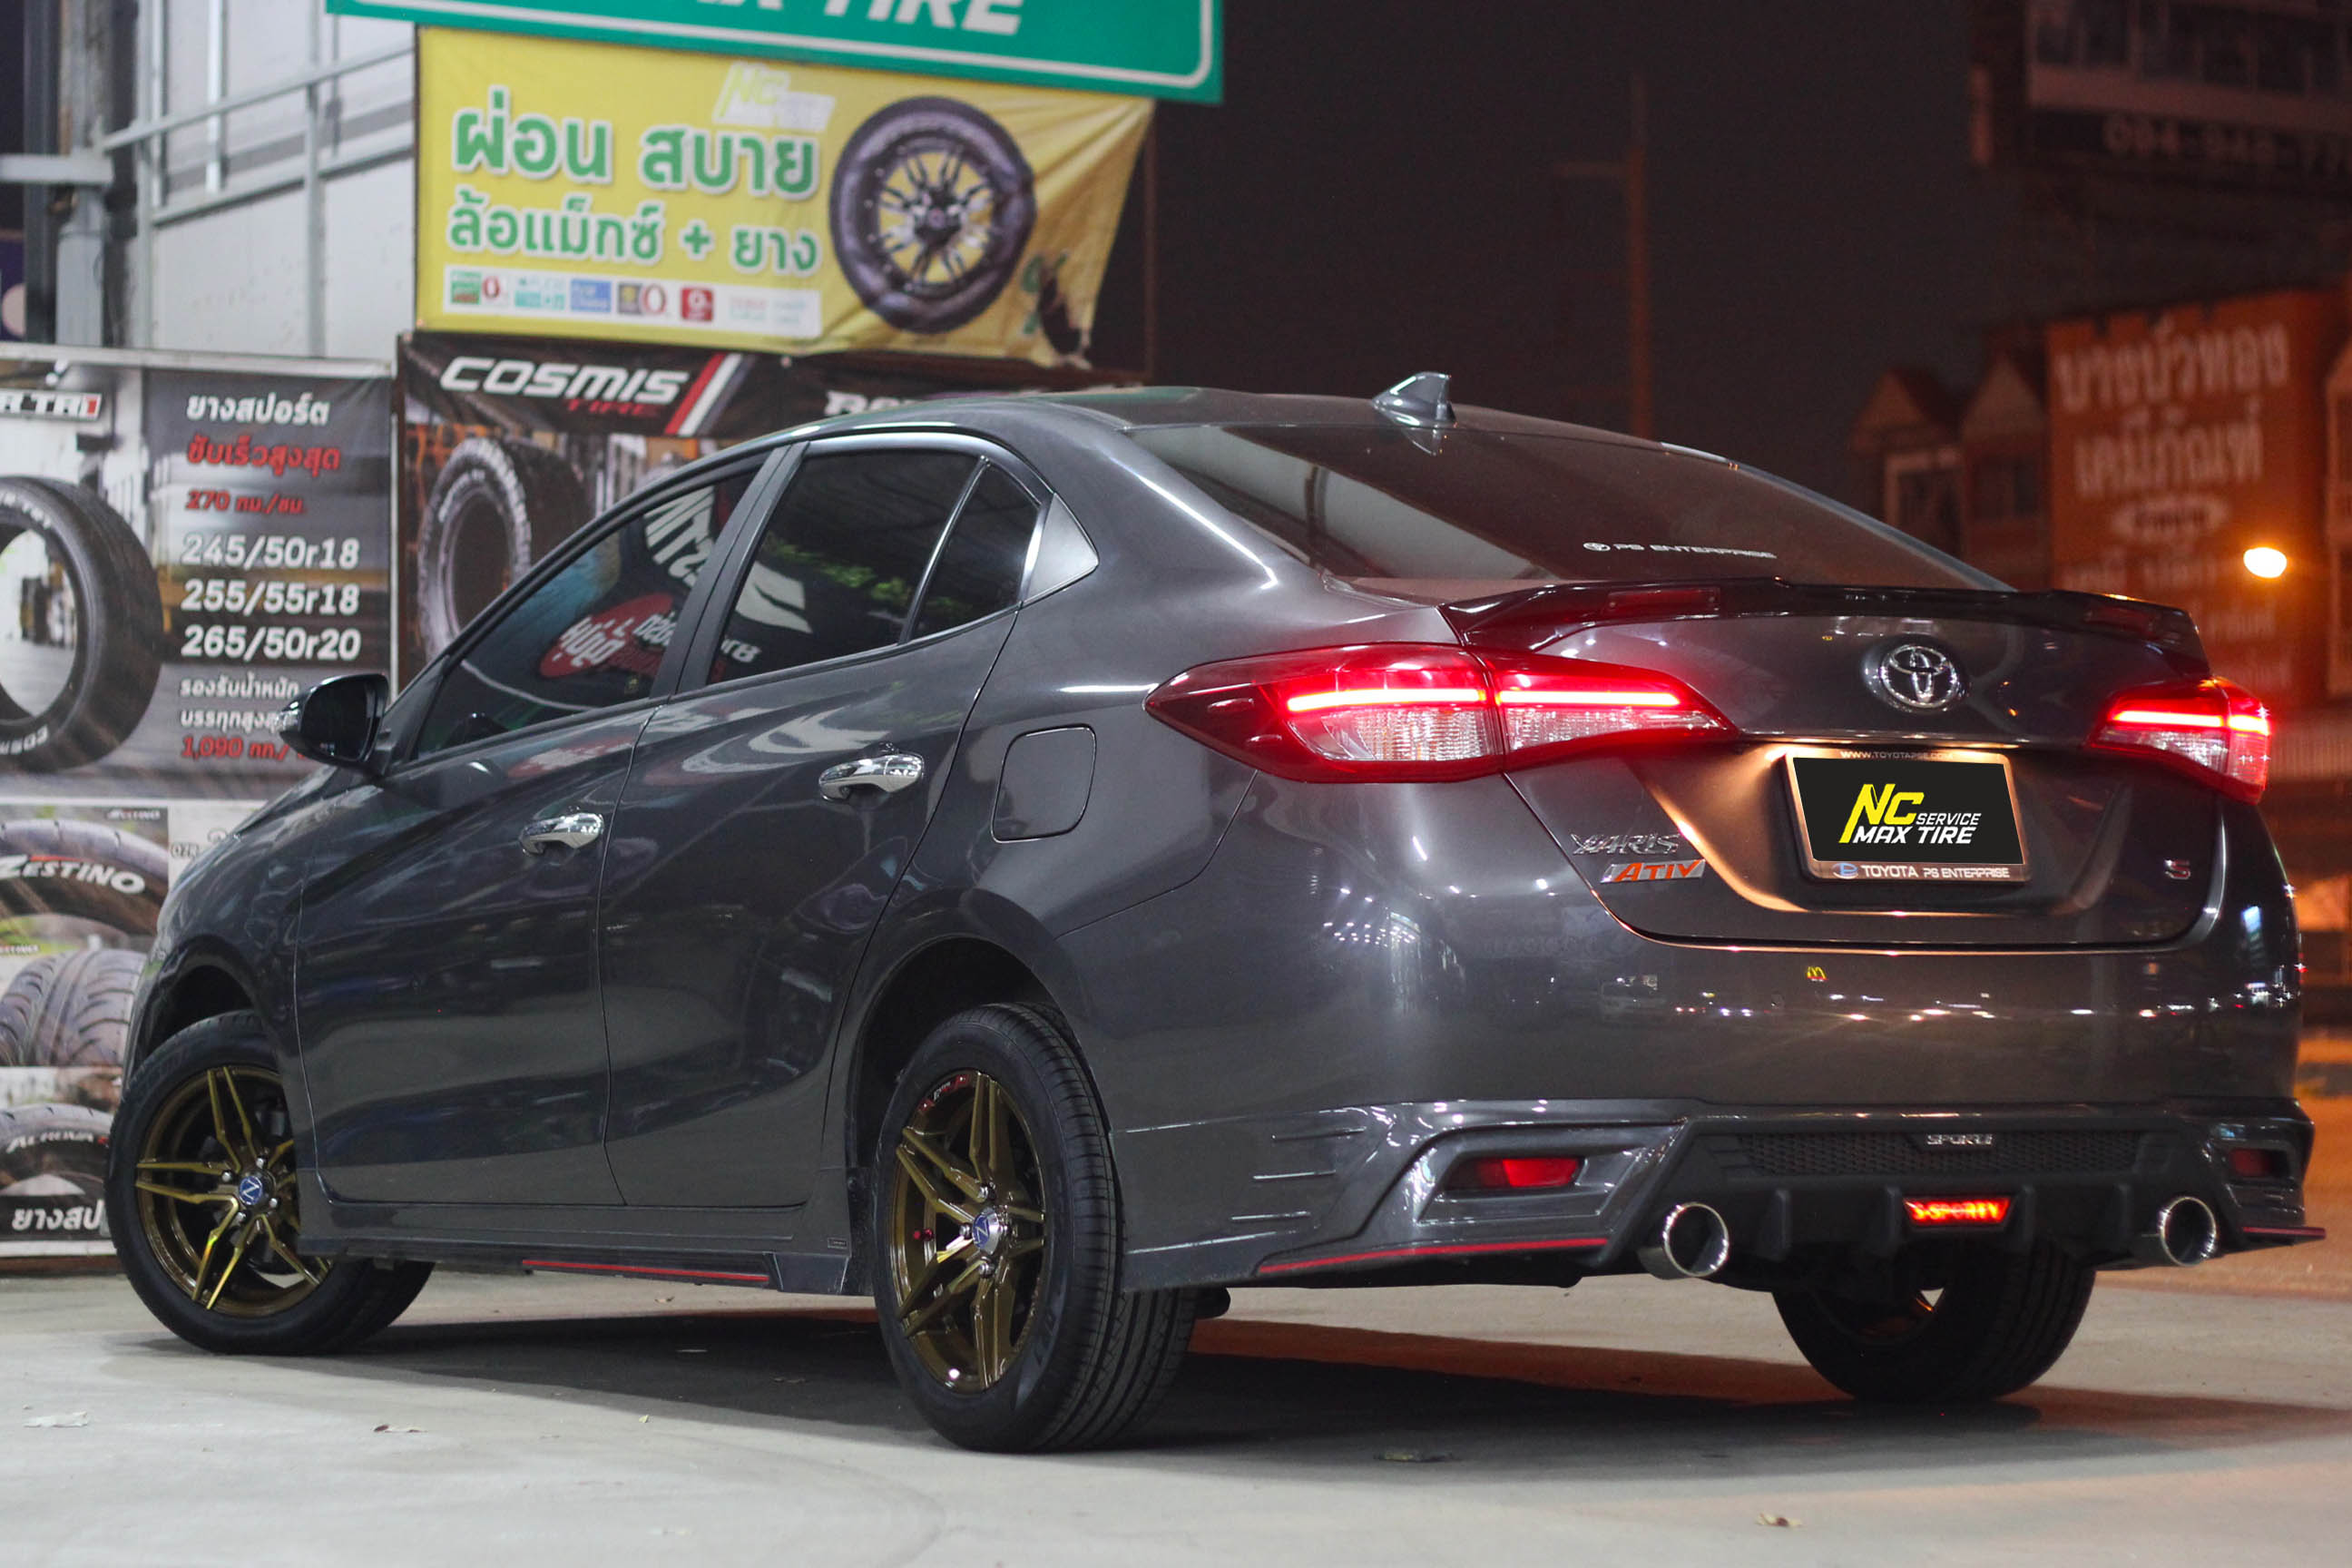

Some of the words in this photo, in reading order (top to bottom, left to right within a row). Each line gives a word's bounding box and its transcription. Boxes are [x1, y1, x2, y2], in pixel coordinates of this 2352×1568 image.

[455, 88, 608, 179] ผ่อน
[641, 128, 815, 195] สบาย
[448, 188, 663, 261] ล้อแม็กซ์
[733, 229, 818, 271] ยาง
[439, 356, 690, 405] COSMIS
[186, 391, 330, 426] ยางสปอร์ต
[185, 489, 230, 511] 270
[181, 534, 360, 571] 245/50r18
[181, 578, 360, 617] 255/55r18
[181, 623, 362, 662] 265/50r20
[182, 736, 243, 760] 1,090
[1570, 832, 1681, 855] YARIS
[1860, 865, 1919, 878] TOYOTA
[1941, 867, 2011, 879] ENTERPRISE
